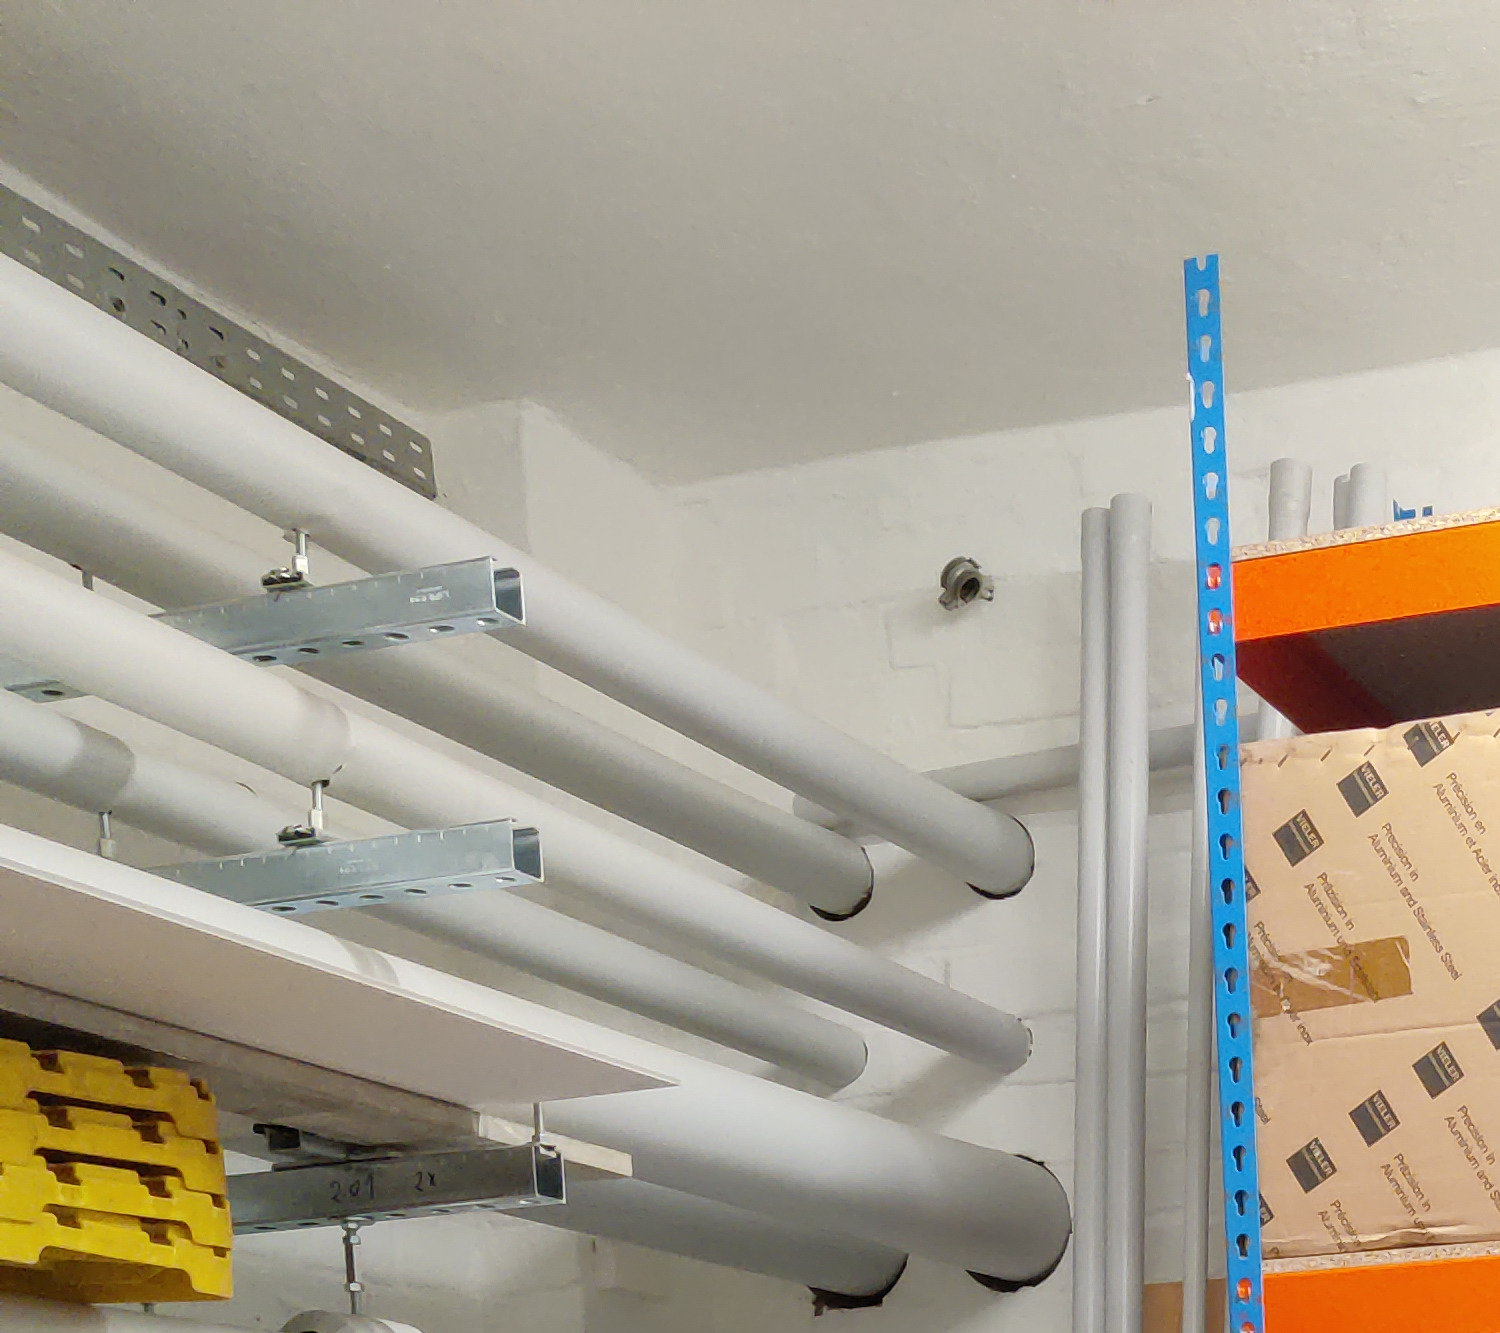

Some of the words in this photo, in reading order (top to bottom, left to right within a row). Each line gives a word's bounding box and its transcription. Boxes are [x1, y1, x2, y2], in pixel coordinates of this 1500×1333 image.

[1361, 763, 1384, 799] VIELER
[1445, 772, 1477, 821] Précision
[1473, 820, 1486, 835] en
[1295, 813, 1319, 848] VIELER
[1381, 822, 1412, 871] Precision
[1408, 868, 1418, 882] in
[1432, 783, 1467, 837] Aluminium
[1465, 836, 1476, 849] et
[1471, 848, 1492, 875] Acier
[1303, 883, 1340, 937] Aluminium
[1316, 871, 1347, 920] Präzision
[1344, 918, 1354, 931] in
[1367, 833, 1403, 887] Aluminium
[1399, 886, 1418, 908] and
[1412, 906, 1443, 954] Stainless
[1440, 952, 1462, 981] Steel
[1436, 1045, 1459, 1081] VIELER
[1372, 1093, 1395, 1129] VIELER
[1456, 1104, 1488, 1154] Precision
[1485, 1152, 1495, 1166] in
[1309, 1141, 1332, 1176] VIELER
[1392, 1152, 1424, 1201] Präzision
[1421, 1199, 1431, 1212] in
[1443, 1116, 1479, 1170] Aluminium
[1476, 1169, 1494, 1191] and
[1379, 1163, 1416, 1217] Aluminium
